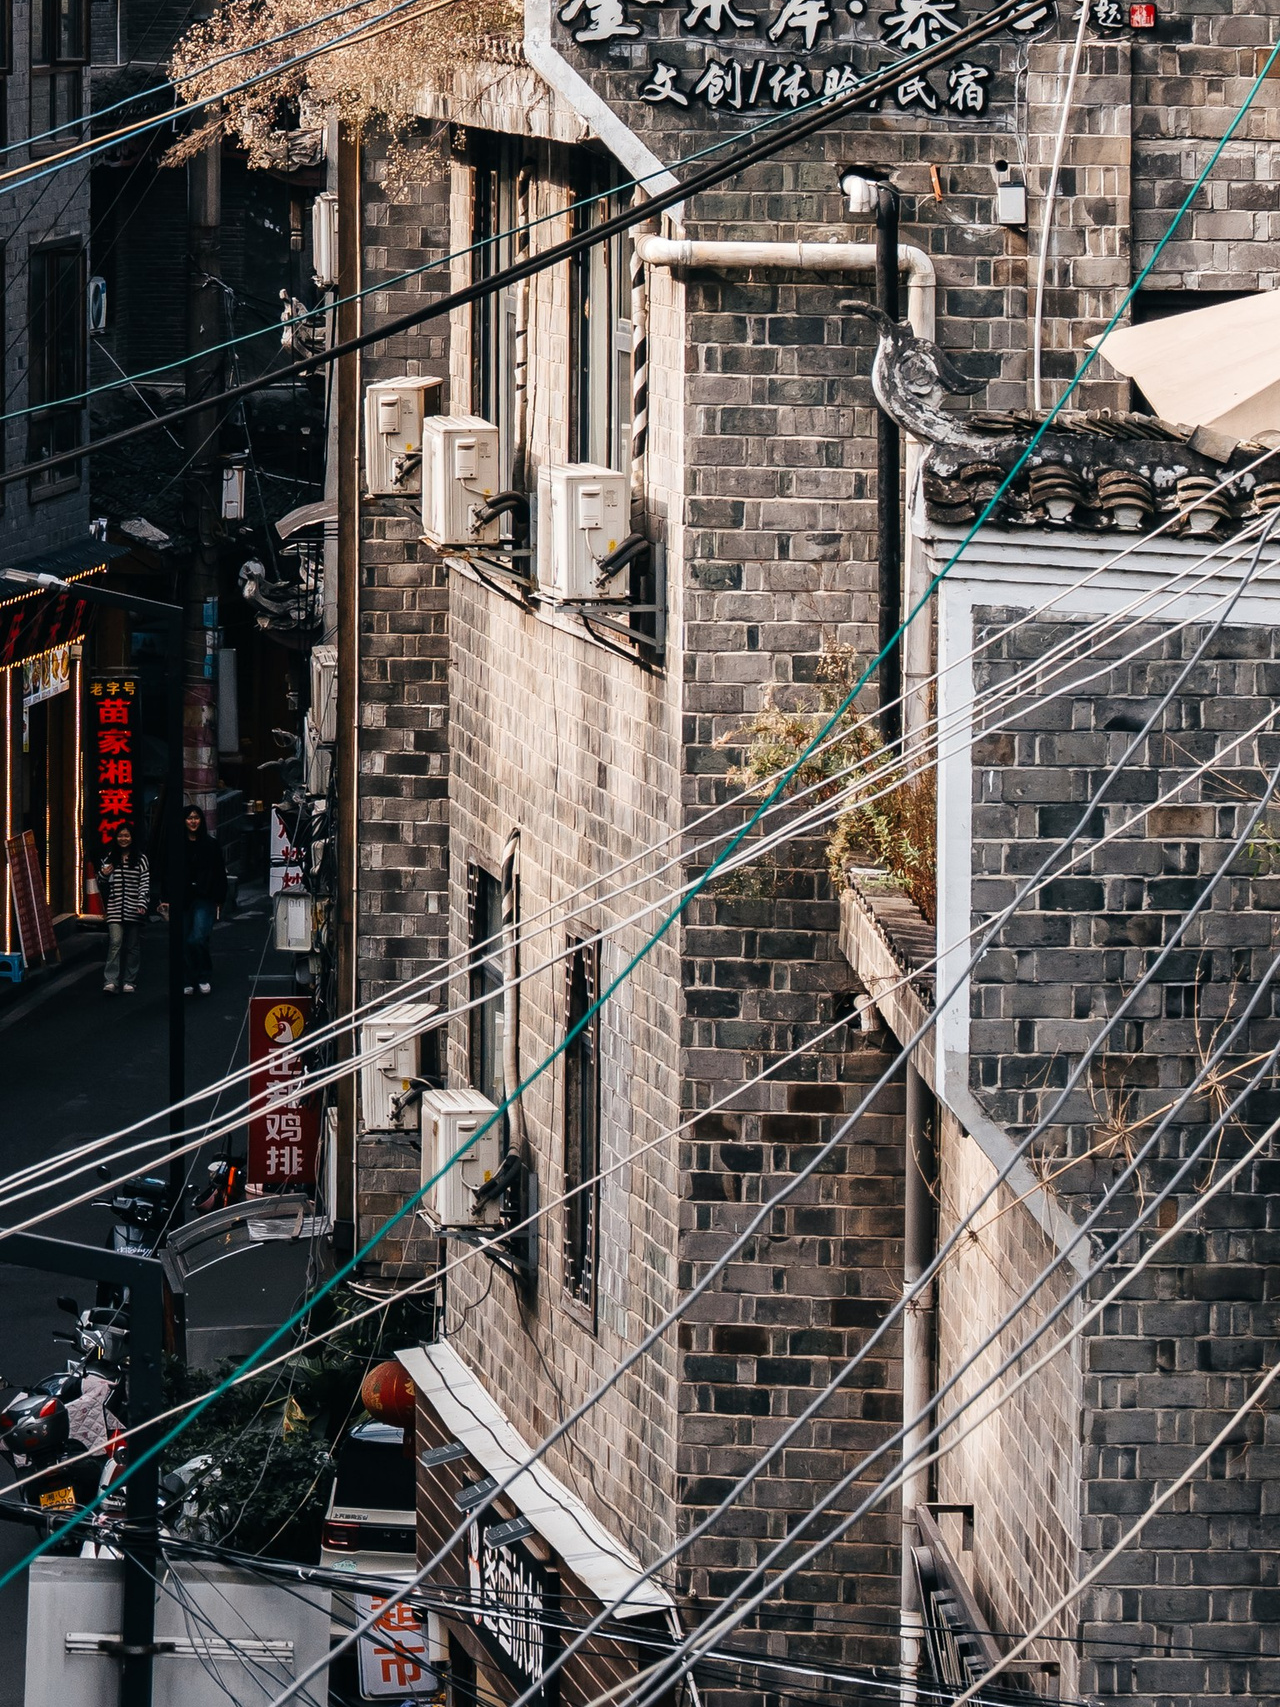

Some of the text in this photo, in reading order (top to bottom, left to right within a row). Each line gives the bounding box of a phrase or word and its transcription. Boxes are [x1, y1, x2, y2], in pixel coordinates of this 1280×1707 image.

[89, 681, 137, 697] 老字号
[265, 1046, 304, 1176] 正新鸡排
[370, 1593, 426, 1687] 超市
